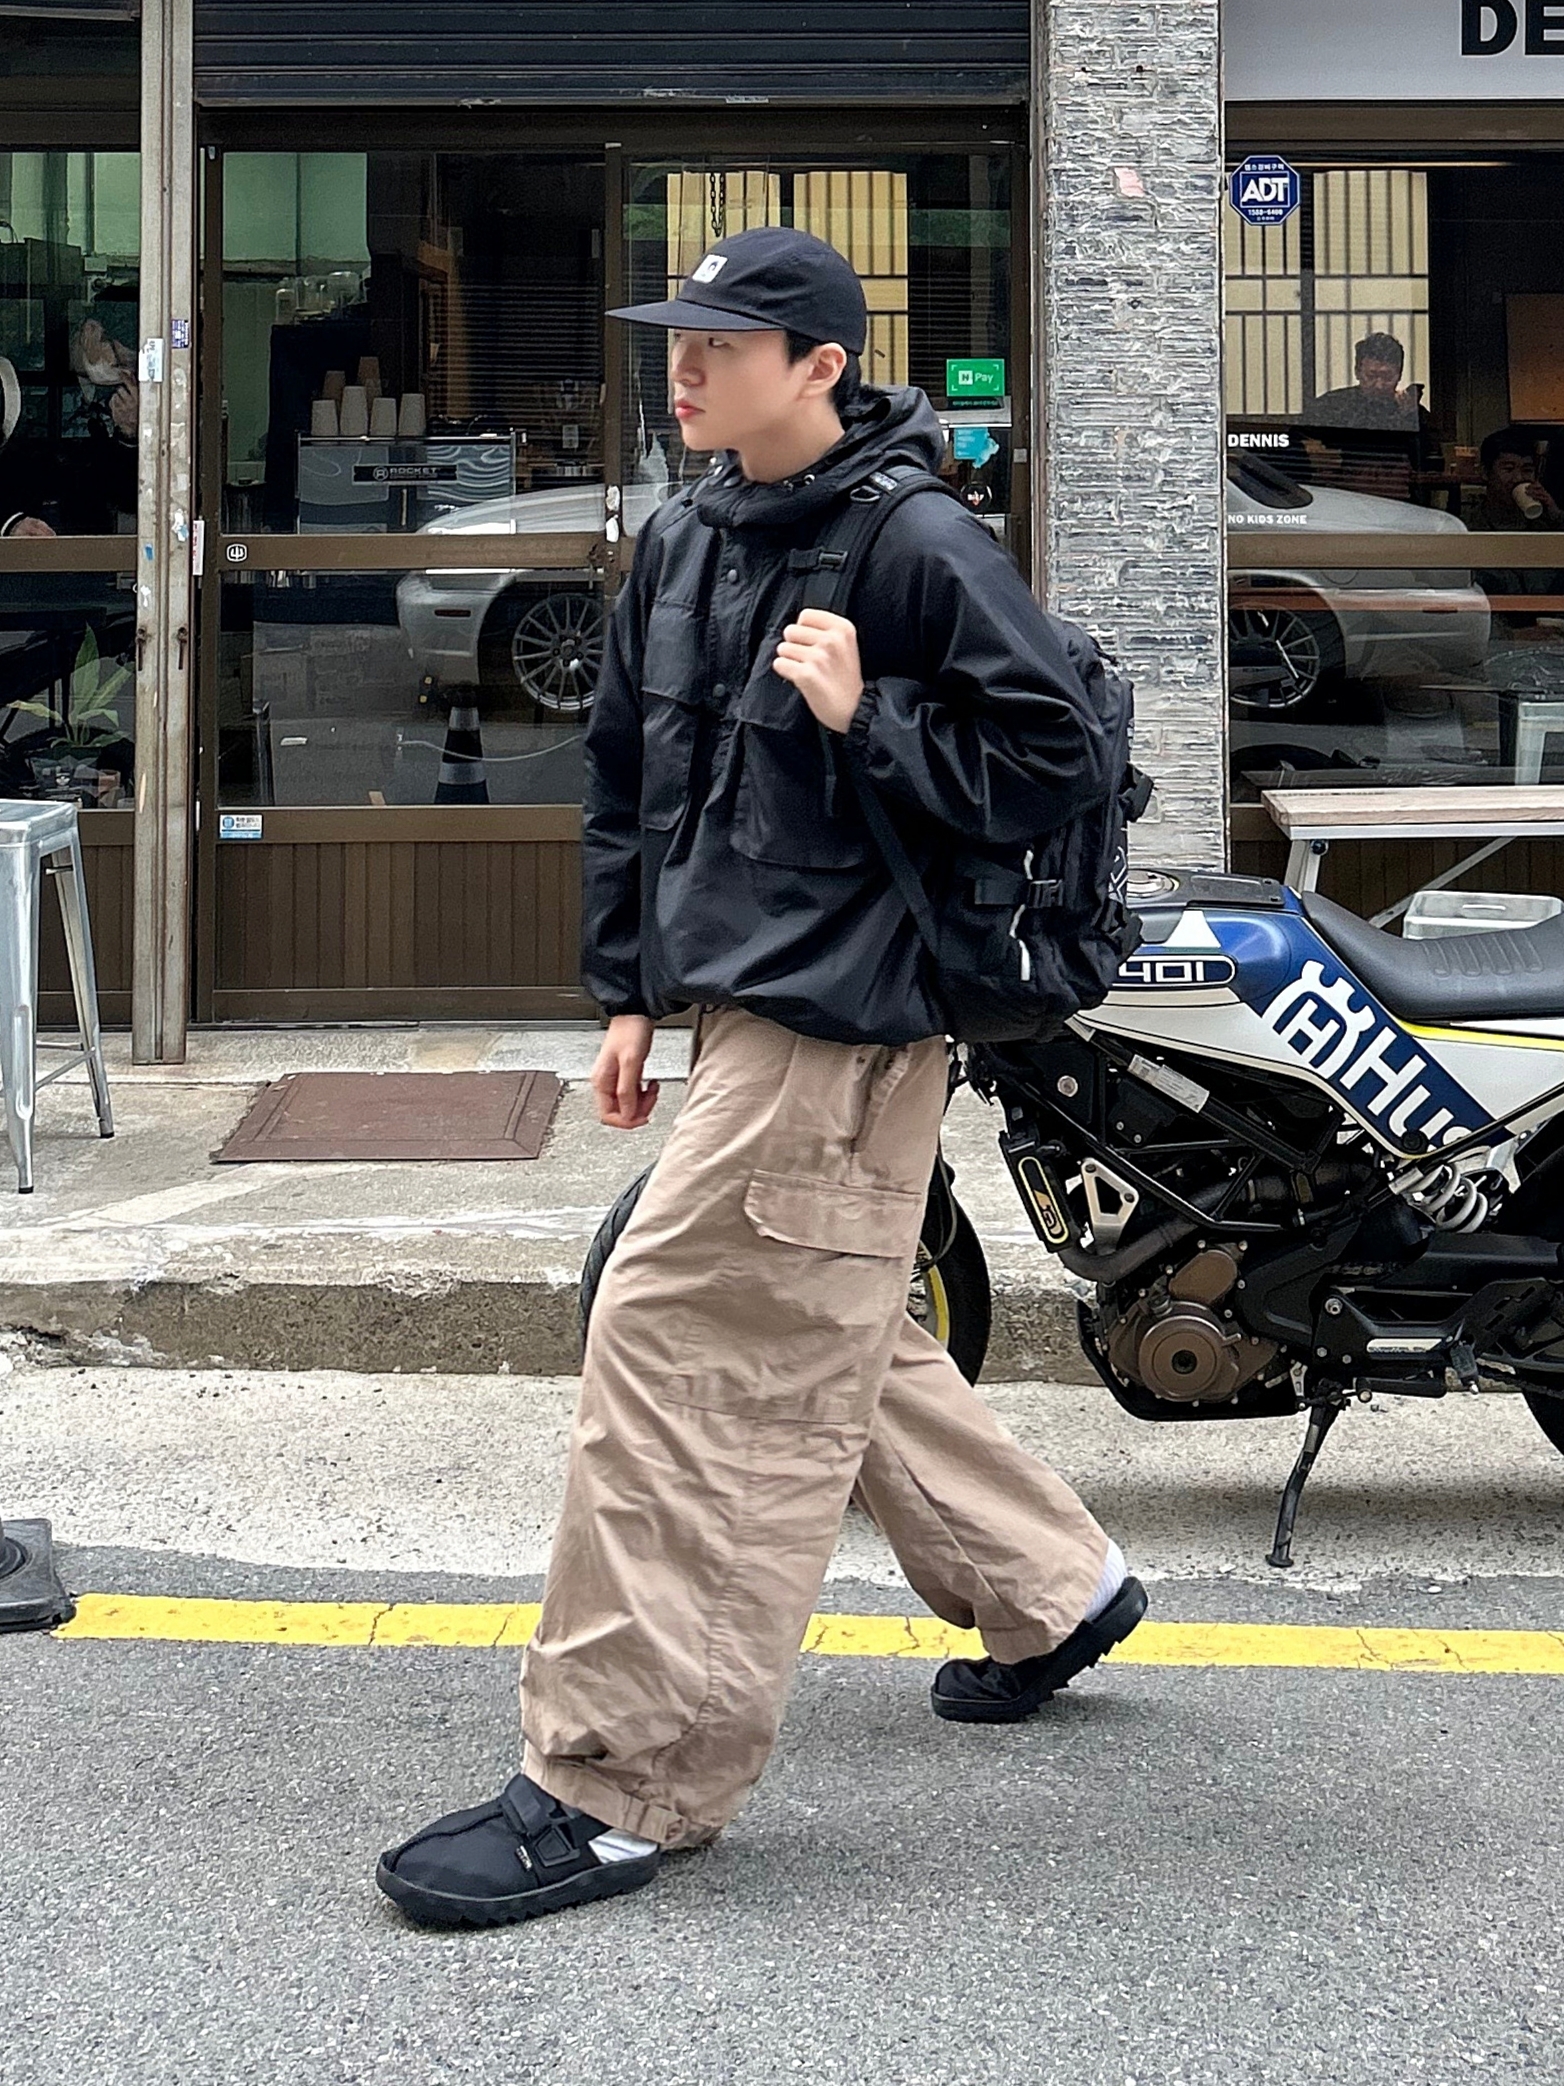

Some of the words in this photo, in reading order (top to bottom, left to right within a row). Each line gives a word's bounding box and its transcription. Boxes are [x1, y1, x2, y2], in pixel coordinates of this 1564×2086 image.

[1461, 0, 1564, 55] DE
[1240, 177, 1290, 202] ADT
[974, 372, 994, 384] Pay
[1227, 433, 1290, 448] DENNIS
[389, 467, 437, 475] ROCKET
[1227, 514, 1245, 525] NO
[1247, 514, 1274, 525] KIDS
[1276, 514, 1308, 525] ZONE
